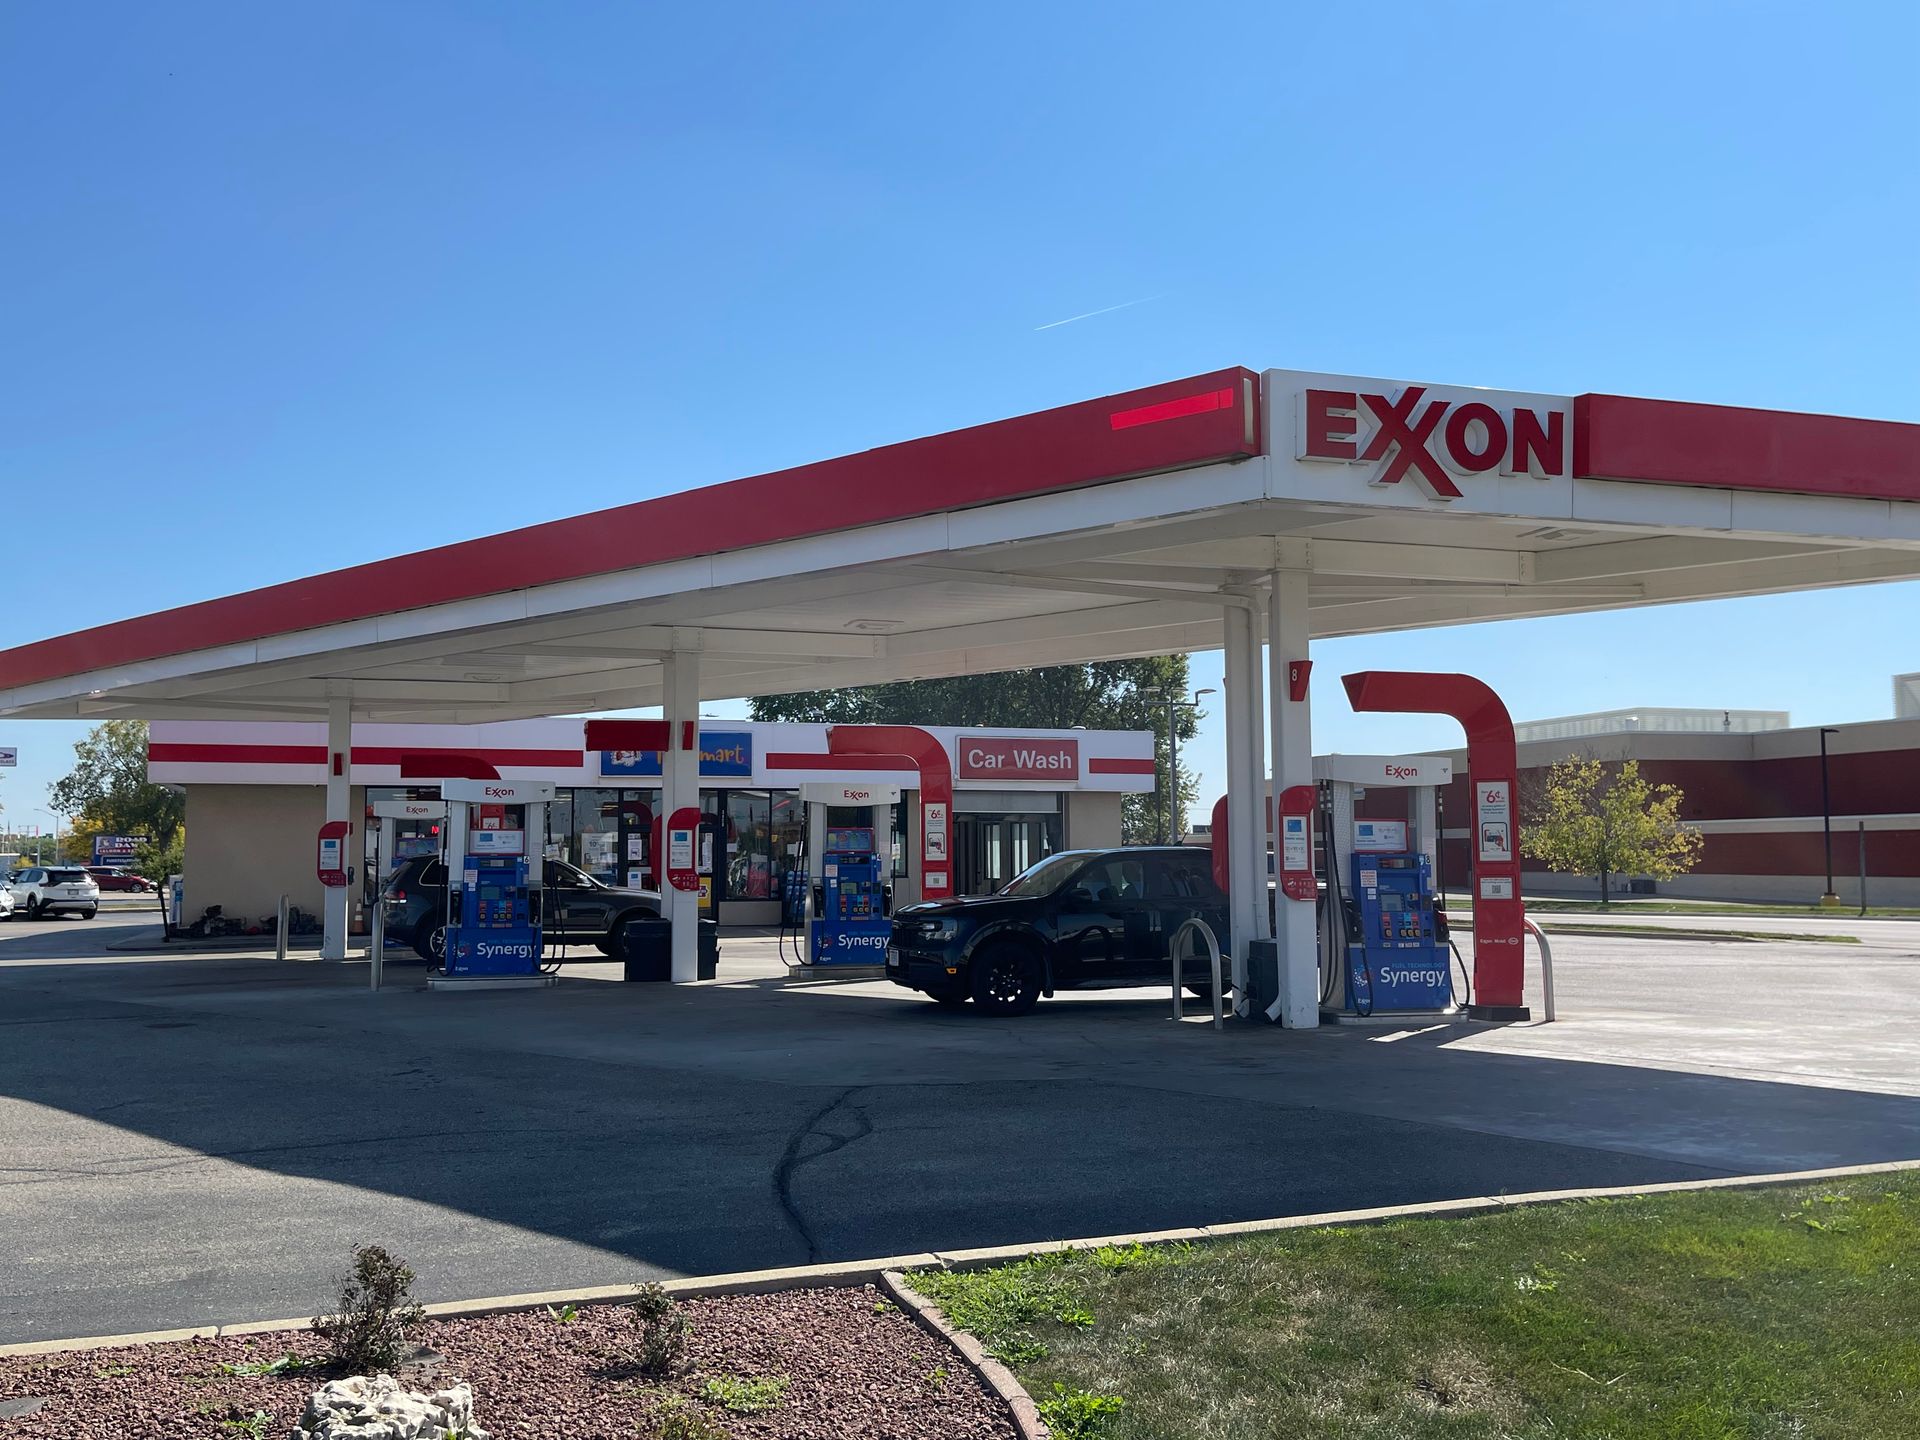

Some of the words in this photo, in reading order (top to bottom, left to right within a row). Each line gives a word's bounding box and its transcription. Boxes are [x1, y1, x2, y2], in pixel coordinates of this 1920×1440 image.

[1305, 386, 1564, 498] EXXON
[1291, 669, 1298, 682] 8
[968, 749, 1005, 768] Car
[1013, 750, 1072, 769] Wash
[1385, 765, 1418, 780] Exxon
[485, 787, 514, 799] Exxon
[843, 789, 869, 800] Exxon
[406, 806, 428, 815] Exxon
[838, 934, 891, 949] Synergy
[477, 943, 536, 958] Synergy
[1380, 966, 1446, 988] Synergy
